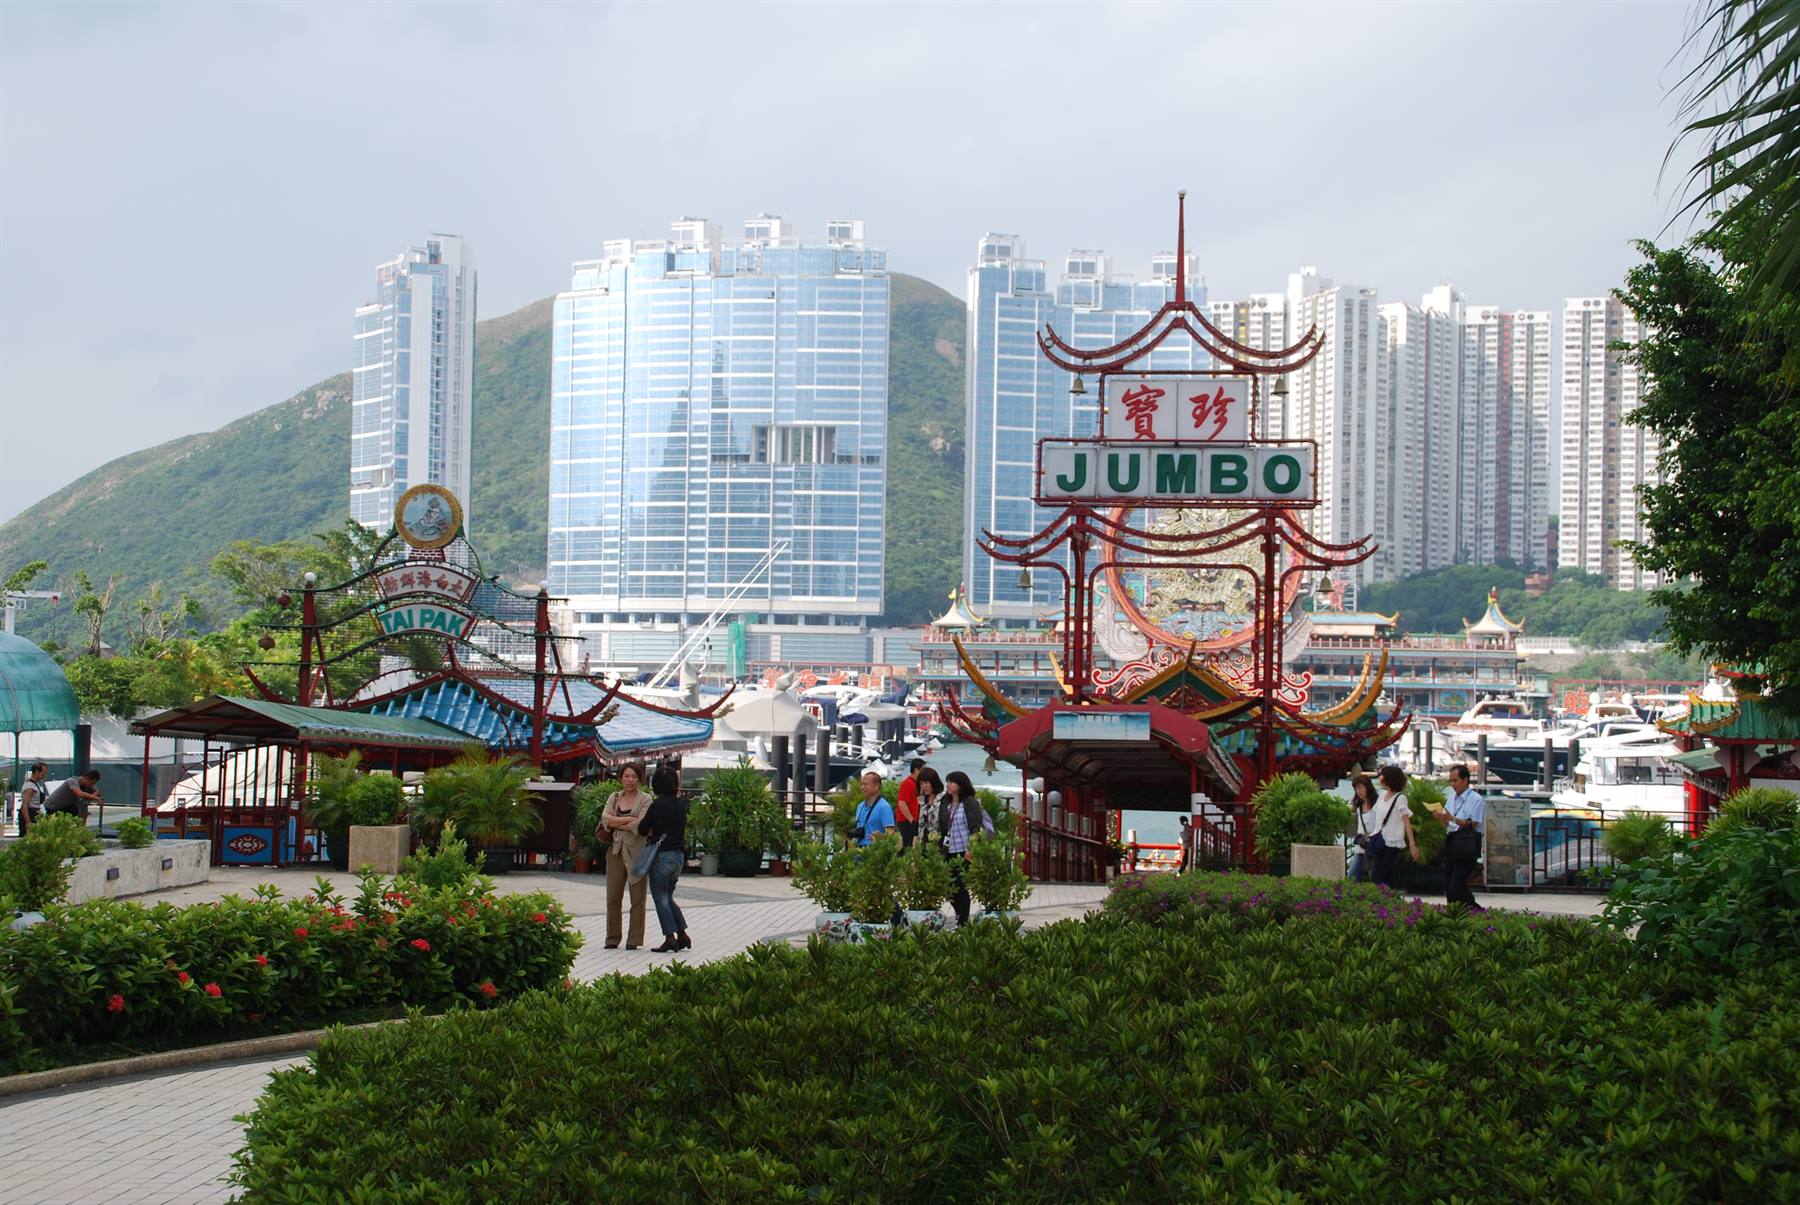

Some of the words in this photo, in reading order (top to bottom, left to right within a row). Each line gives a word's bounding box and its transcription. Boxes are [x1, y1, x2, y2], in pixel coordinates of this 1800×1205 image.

[1056, 453, 1302, 495] JUMBO
[378, 608, 414, 635] TAI
[419, 608, 466, 637] PAK
